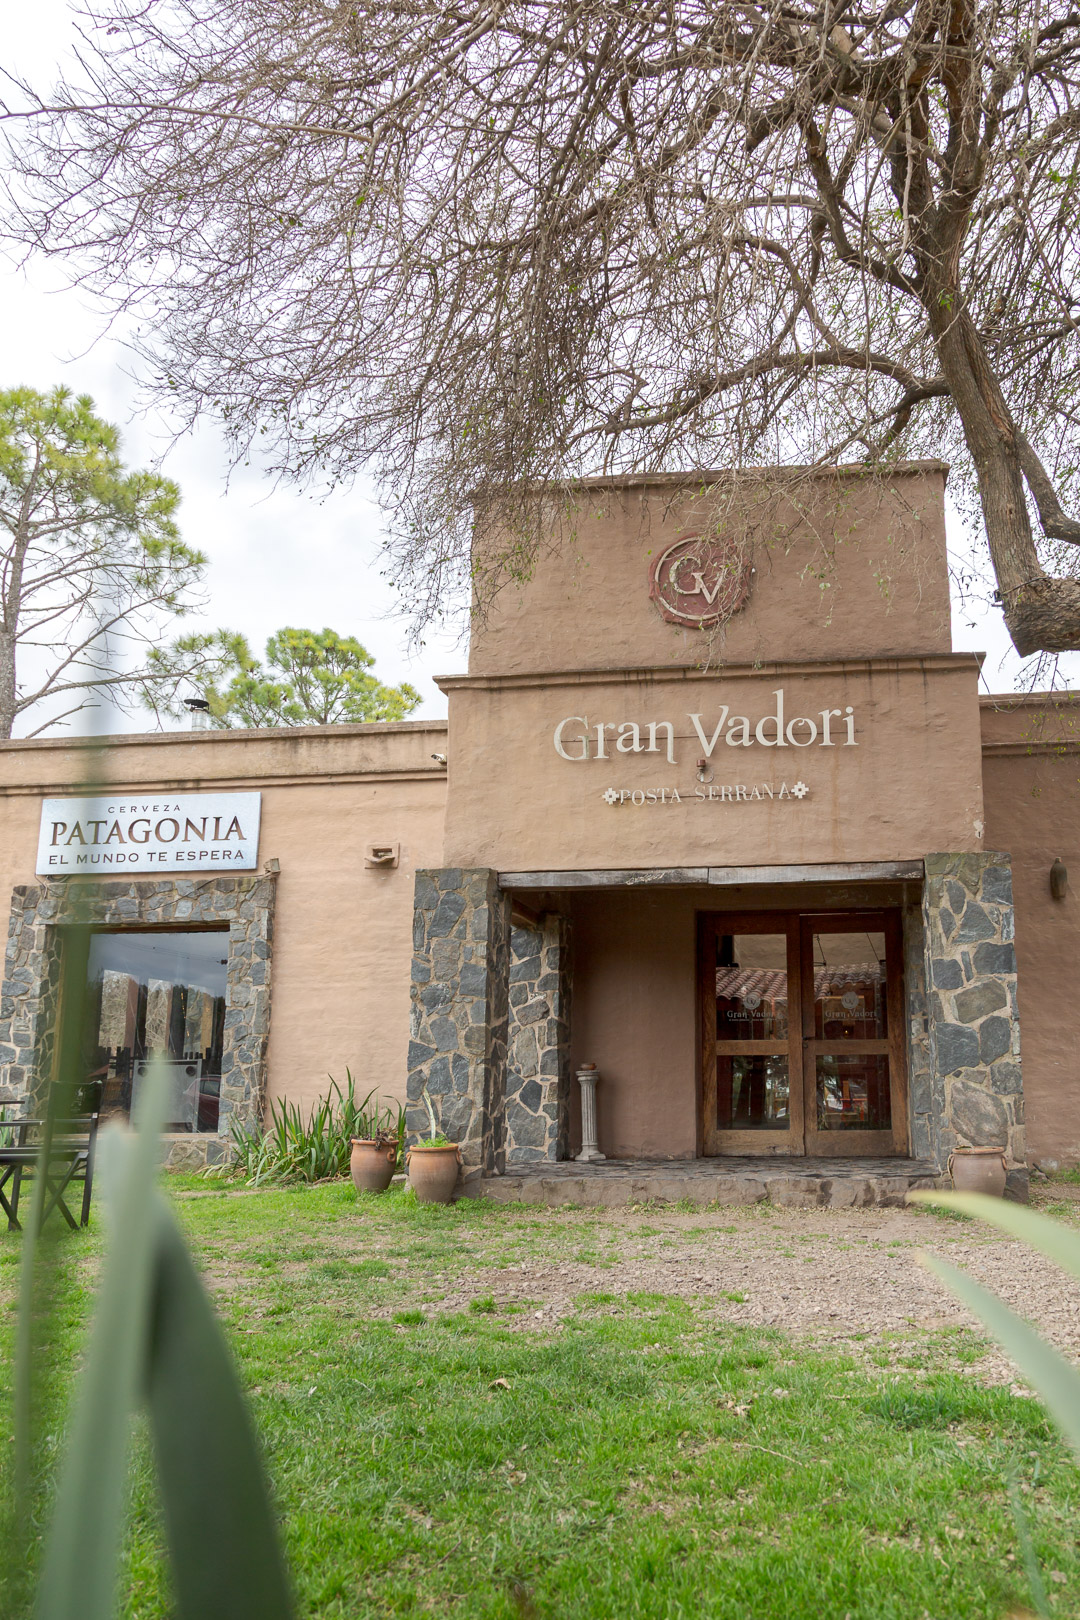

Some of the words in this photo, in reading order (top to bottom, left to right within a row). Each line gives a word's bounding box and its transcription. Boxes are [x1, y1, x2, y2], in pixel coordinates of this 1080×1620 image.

[553, 715, 678, 764] Gran
[686, 688, 859, 758] Vadori
[619, 787, 682, 806] POSTA
[695, 781, 792, 802] SERRANA
[107, 804, 181, 813] CERVEZA
[49, 815, 248, 846] PATAGONIA
[48, 855, 69, 865] EL
[76, 852, 139, 864] MUNDO
[147, 851, 168, 862] TE
[176, 849, 244, 861] ESPERA
[726, 1010, 748, 1019] Gran
